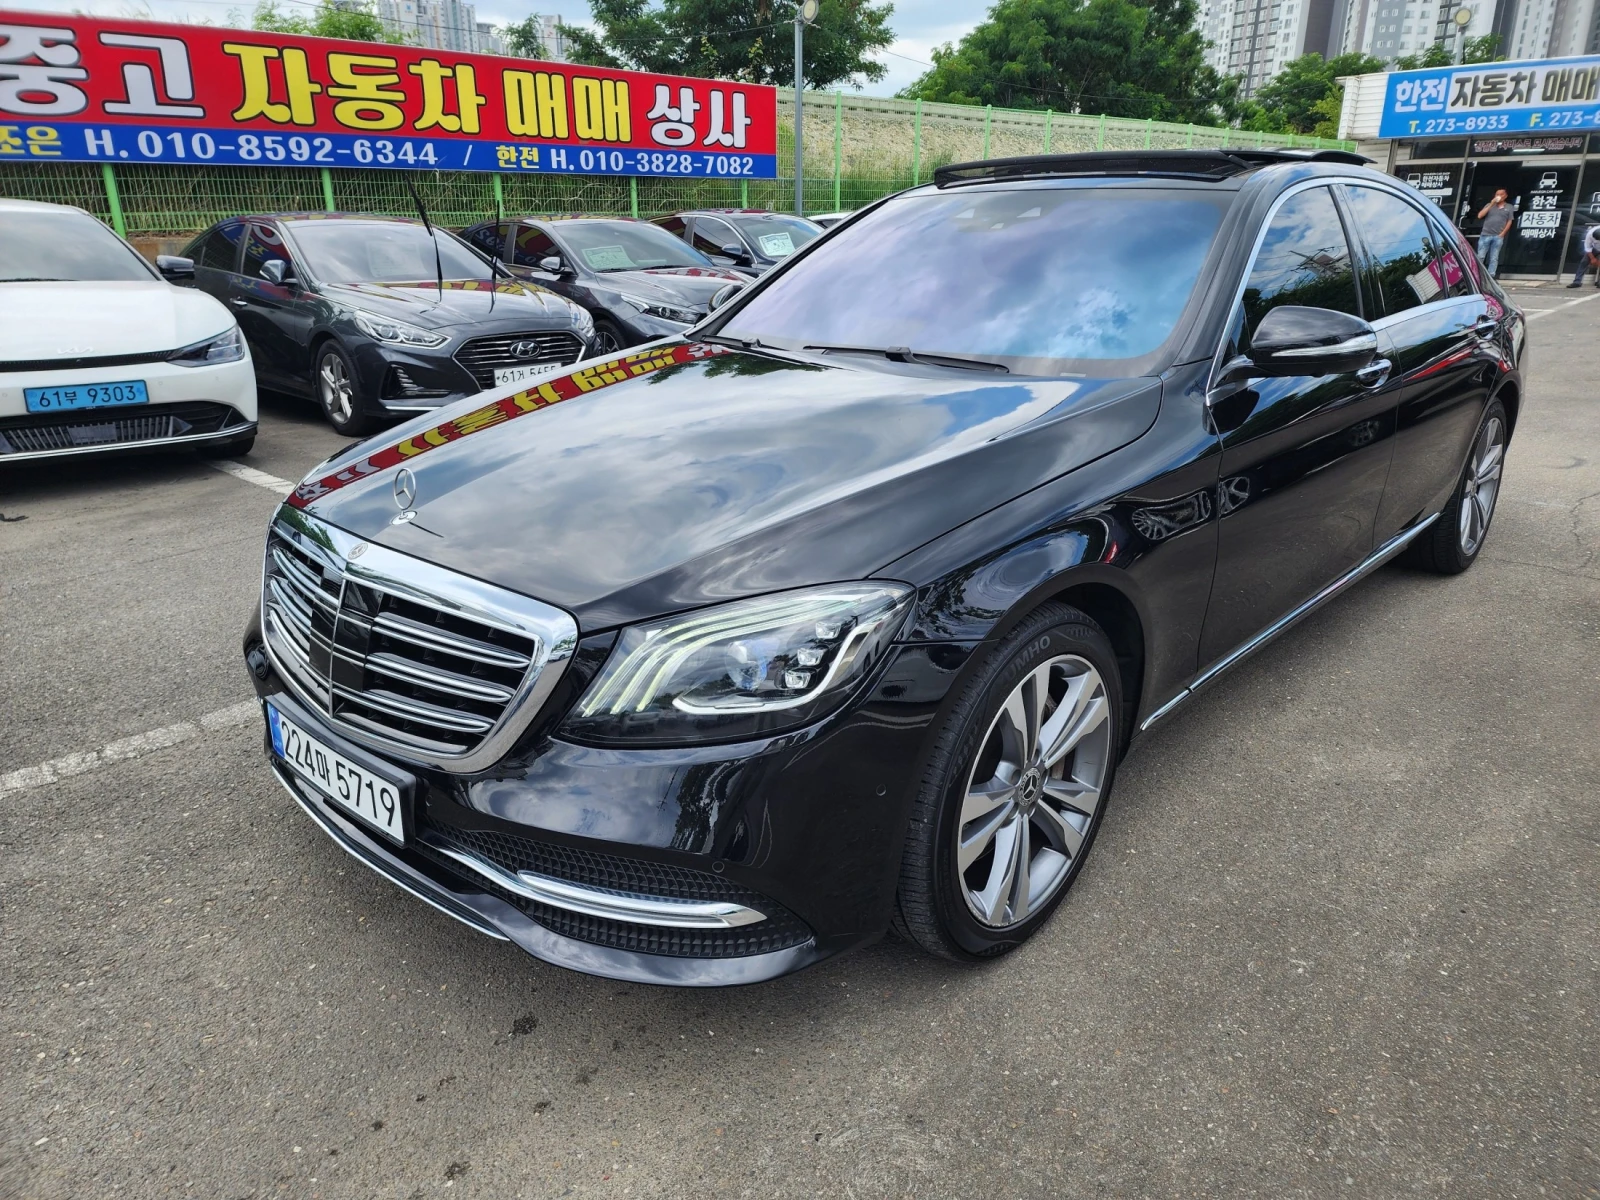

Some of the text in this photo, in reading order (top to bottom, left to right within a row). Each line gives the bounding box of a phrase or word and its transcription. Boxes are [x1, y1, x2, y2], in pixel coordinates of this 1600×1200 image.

[0, 24, 751, 148] 중고 자동차 매매 상사
[1395, 66, 1600, 113] 한전 자동차 매매
[1409, 121, 1421, 133] T.
[1426, 115, 1509, 133] 273-8933
[1530, 113, 1544, 127] F.
[138, 131, 438, 165] 010-8592-6344
[463, 144, 473, 166] /
[496, 145, 539, 169] 한전
[1501, 139, 1531, 150] 서비스로
[1532, 195, 1558, 210] 한전
[1523, 213, 1559, 225] 자동차
[1521, 228, 1556, 239] 매매상사
[40, 385, 136, 407] 61부 9303
[336, 760, 395, 827] 5719
